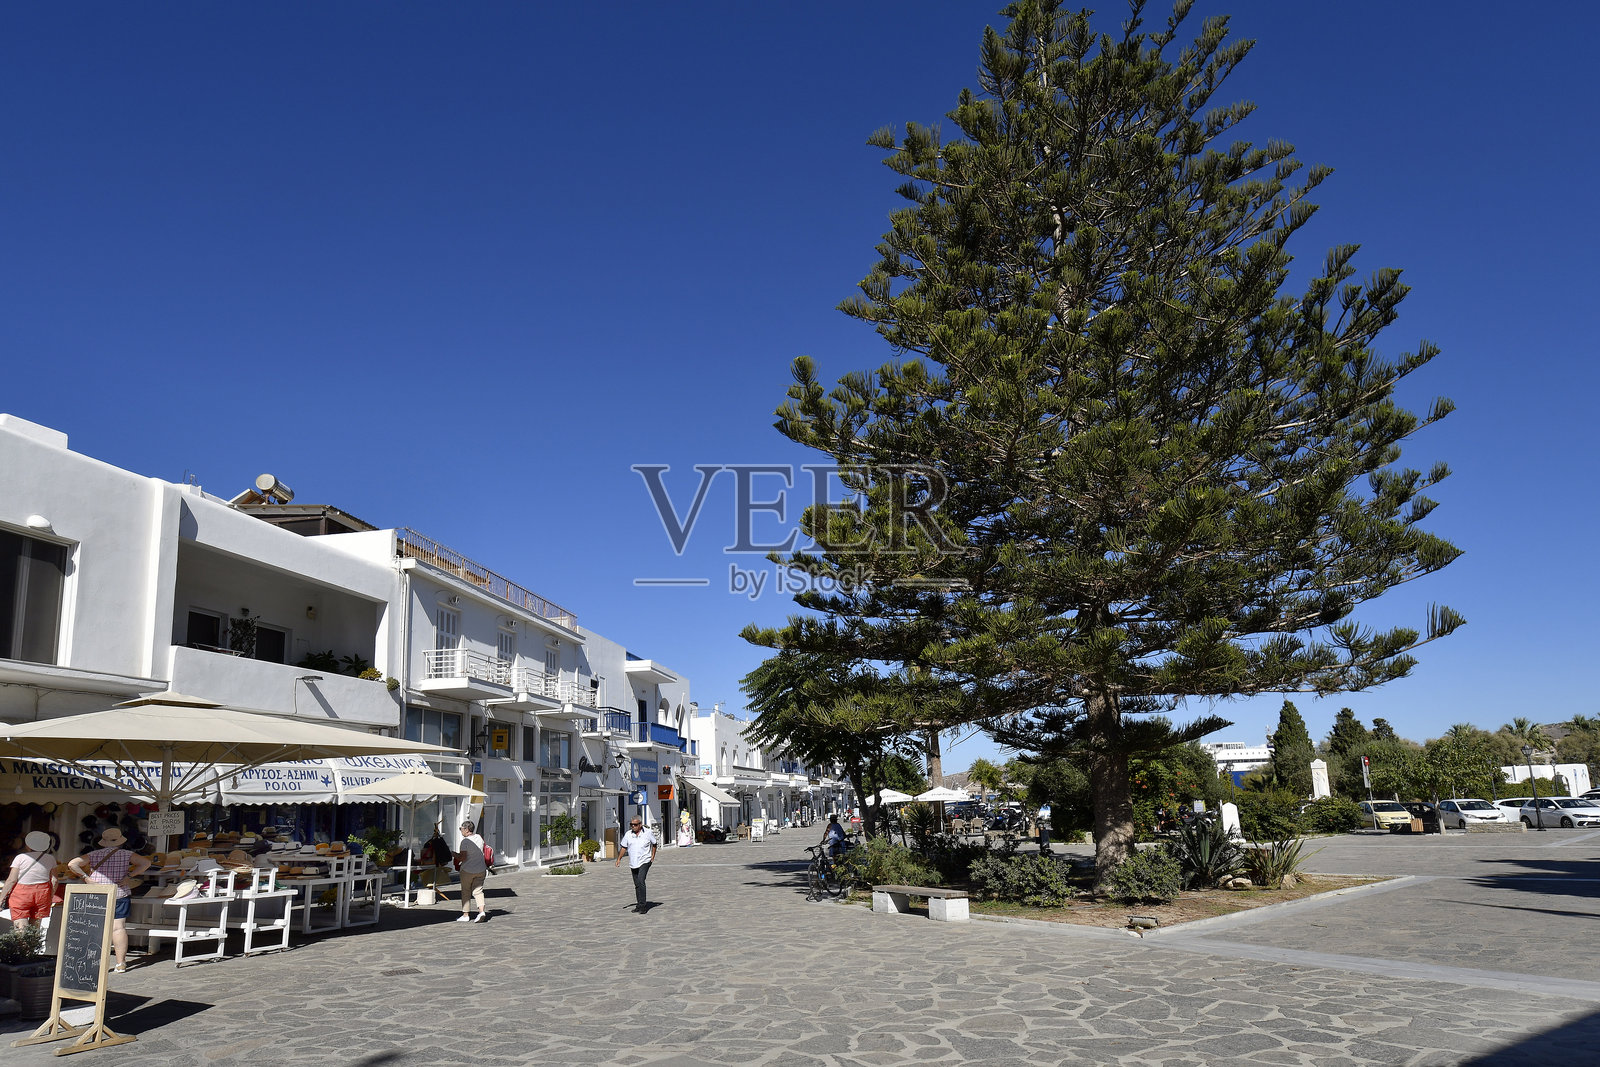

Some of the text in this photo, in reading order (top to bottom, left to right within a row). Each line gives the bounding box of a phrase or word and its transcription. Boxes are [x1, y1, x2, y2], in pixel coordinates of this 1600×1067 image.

[115, 766, 182, 778] CHAPEU
[341, 776, 386, 786] SILVER-
[73, 896, 85, 911] IDEA
